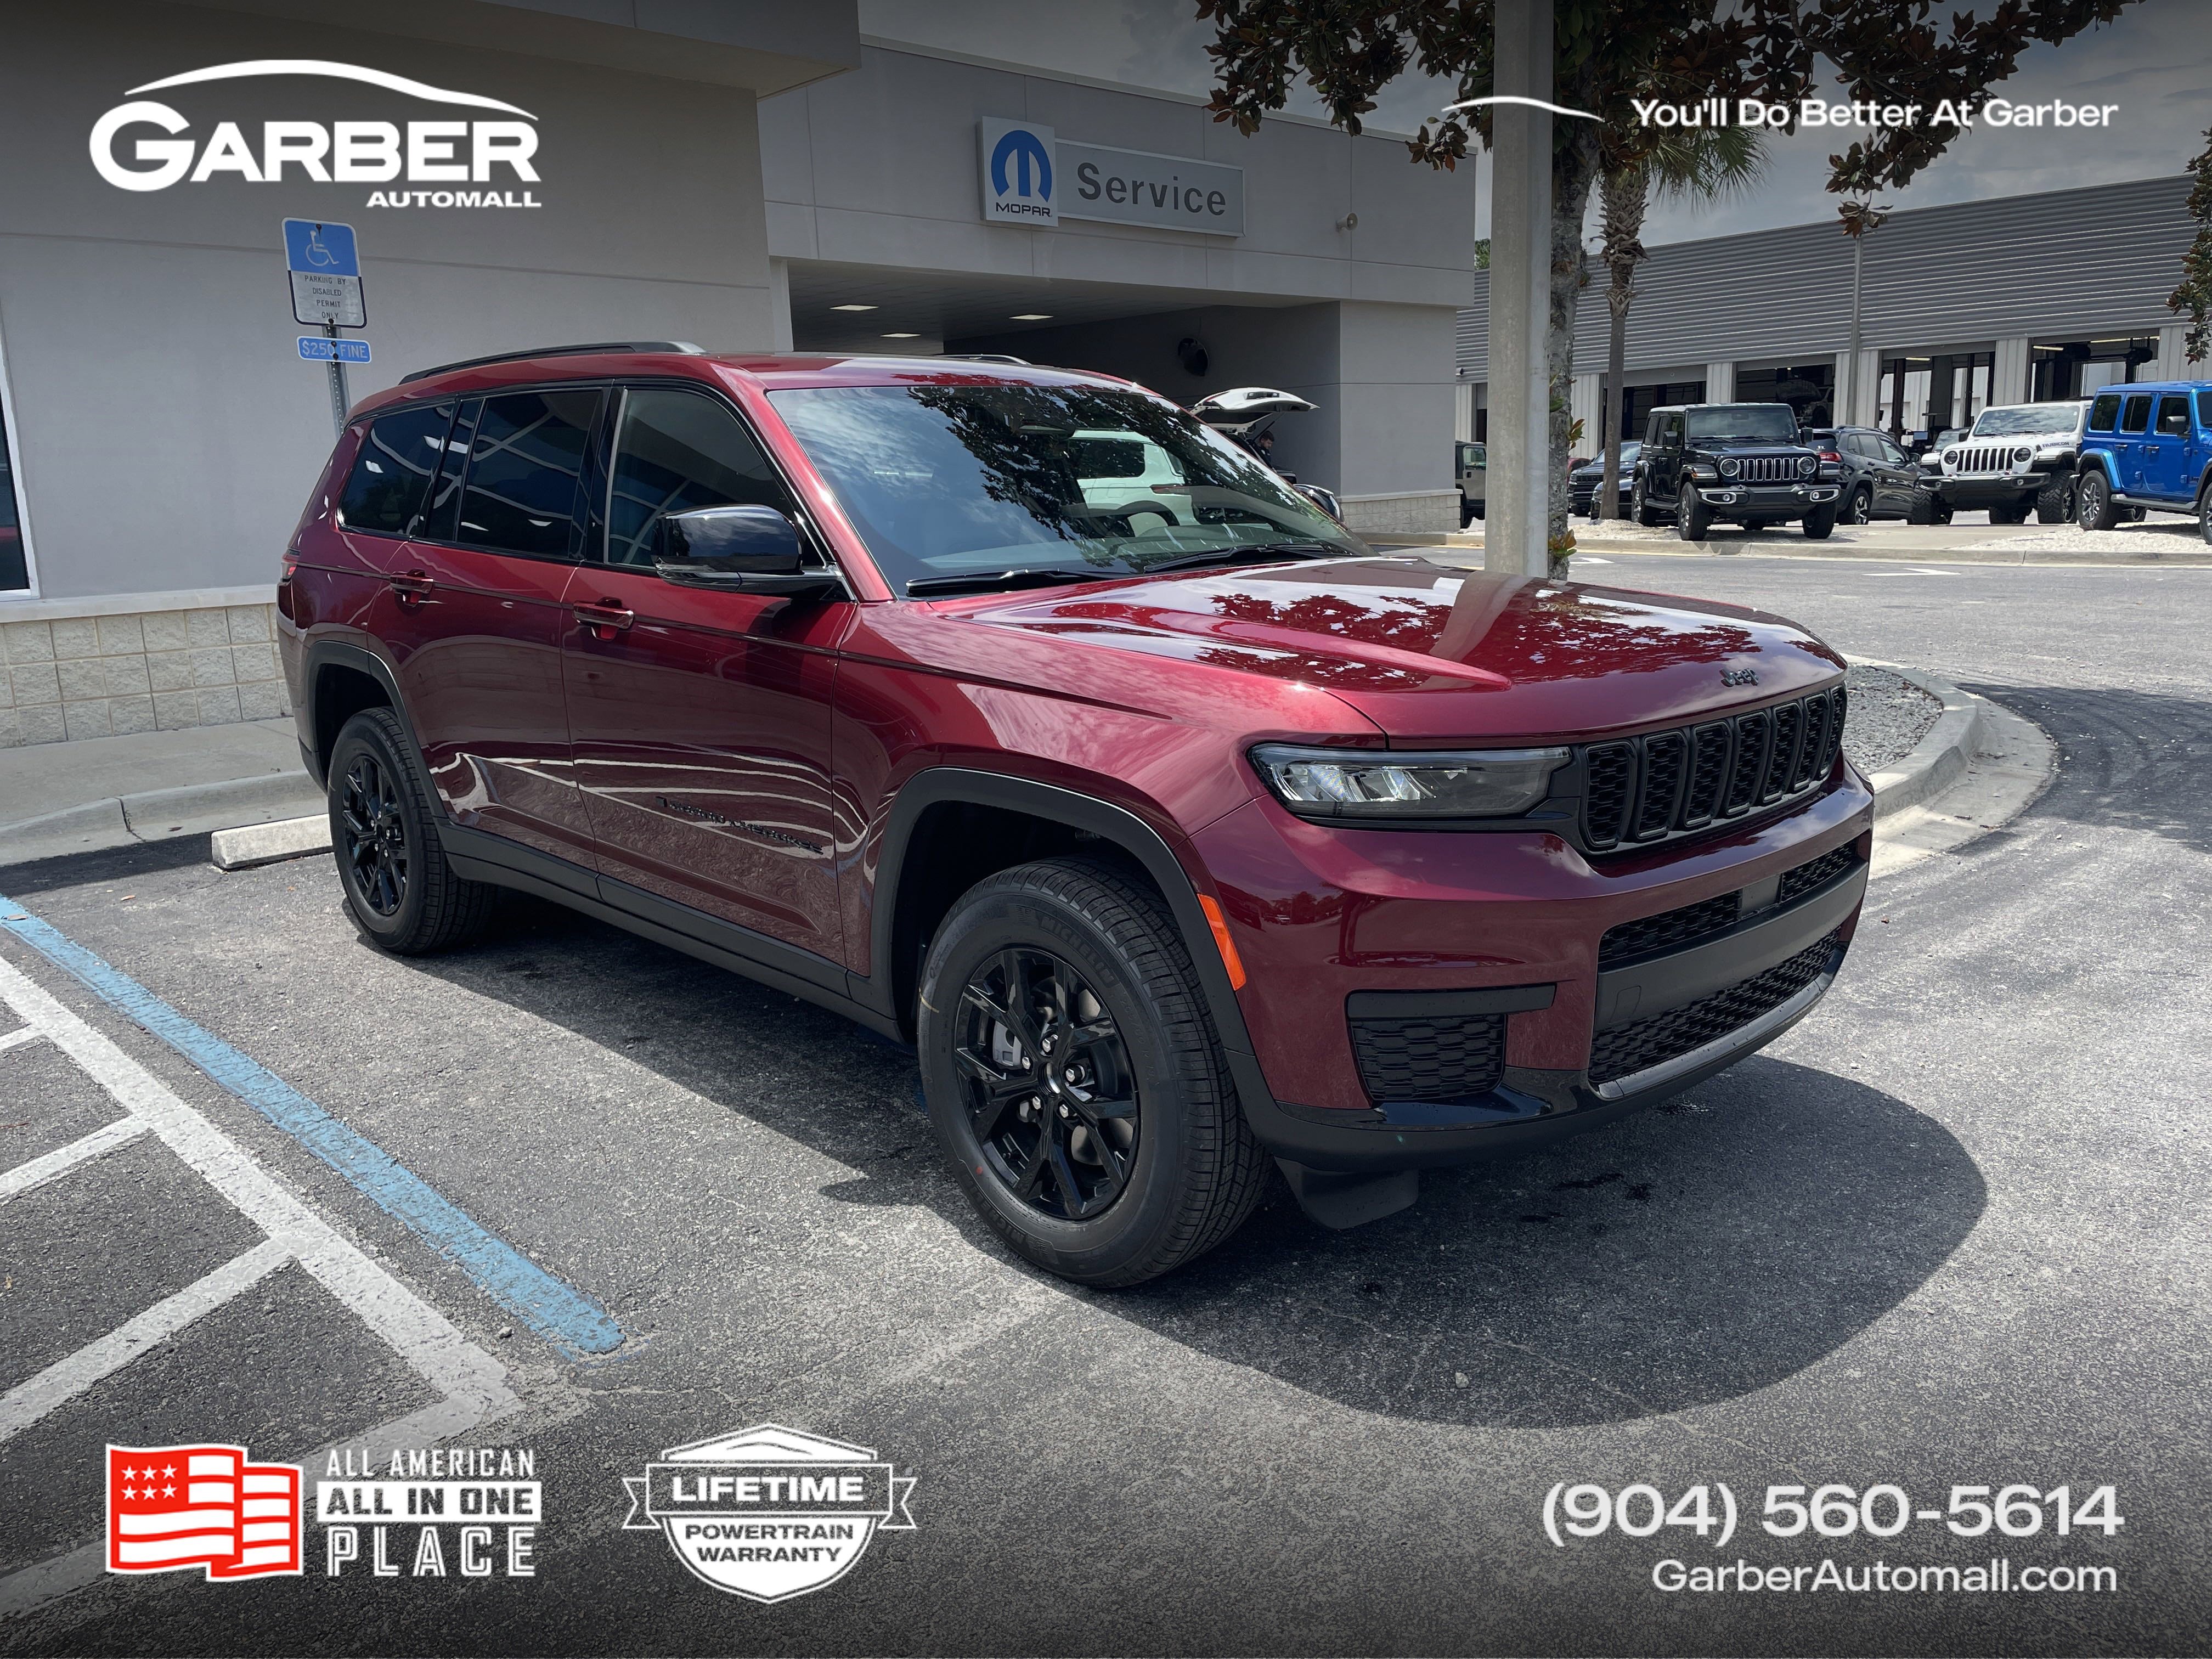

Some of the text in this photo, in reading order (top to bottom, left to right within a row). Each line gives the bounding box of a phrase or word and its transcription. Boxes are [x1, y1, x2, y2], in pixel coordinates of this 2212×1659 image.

[1077, 162, 1226, 216] Service
[996, 202, 1051, 217] MOPAR
[304, 275, 332, 284] PARKING
[312, 287, 342, 296] DISABLED
[316, 299, 341, 308] PERMIT
[302, 340, 368, 359] $250 FINE
[1719, 667, 1760, 687] Jeep
